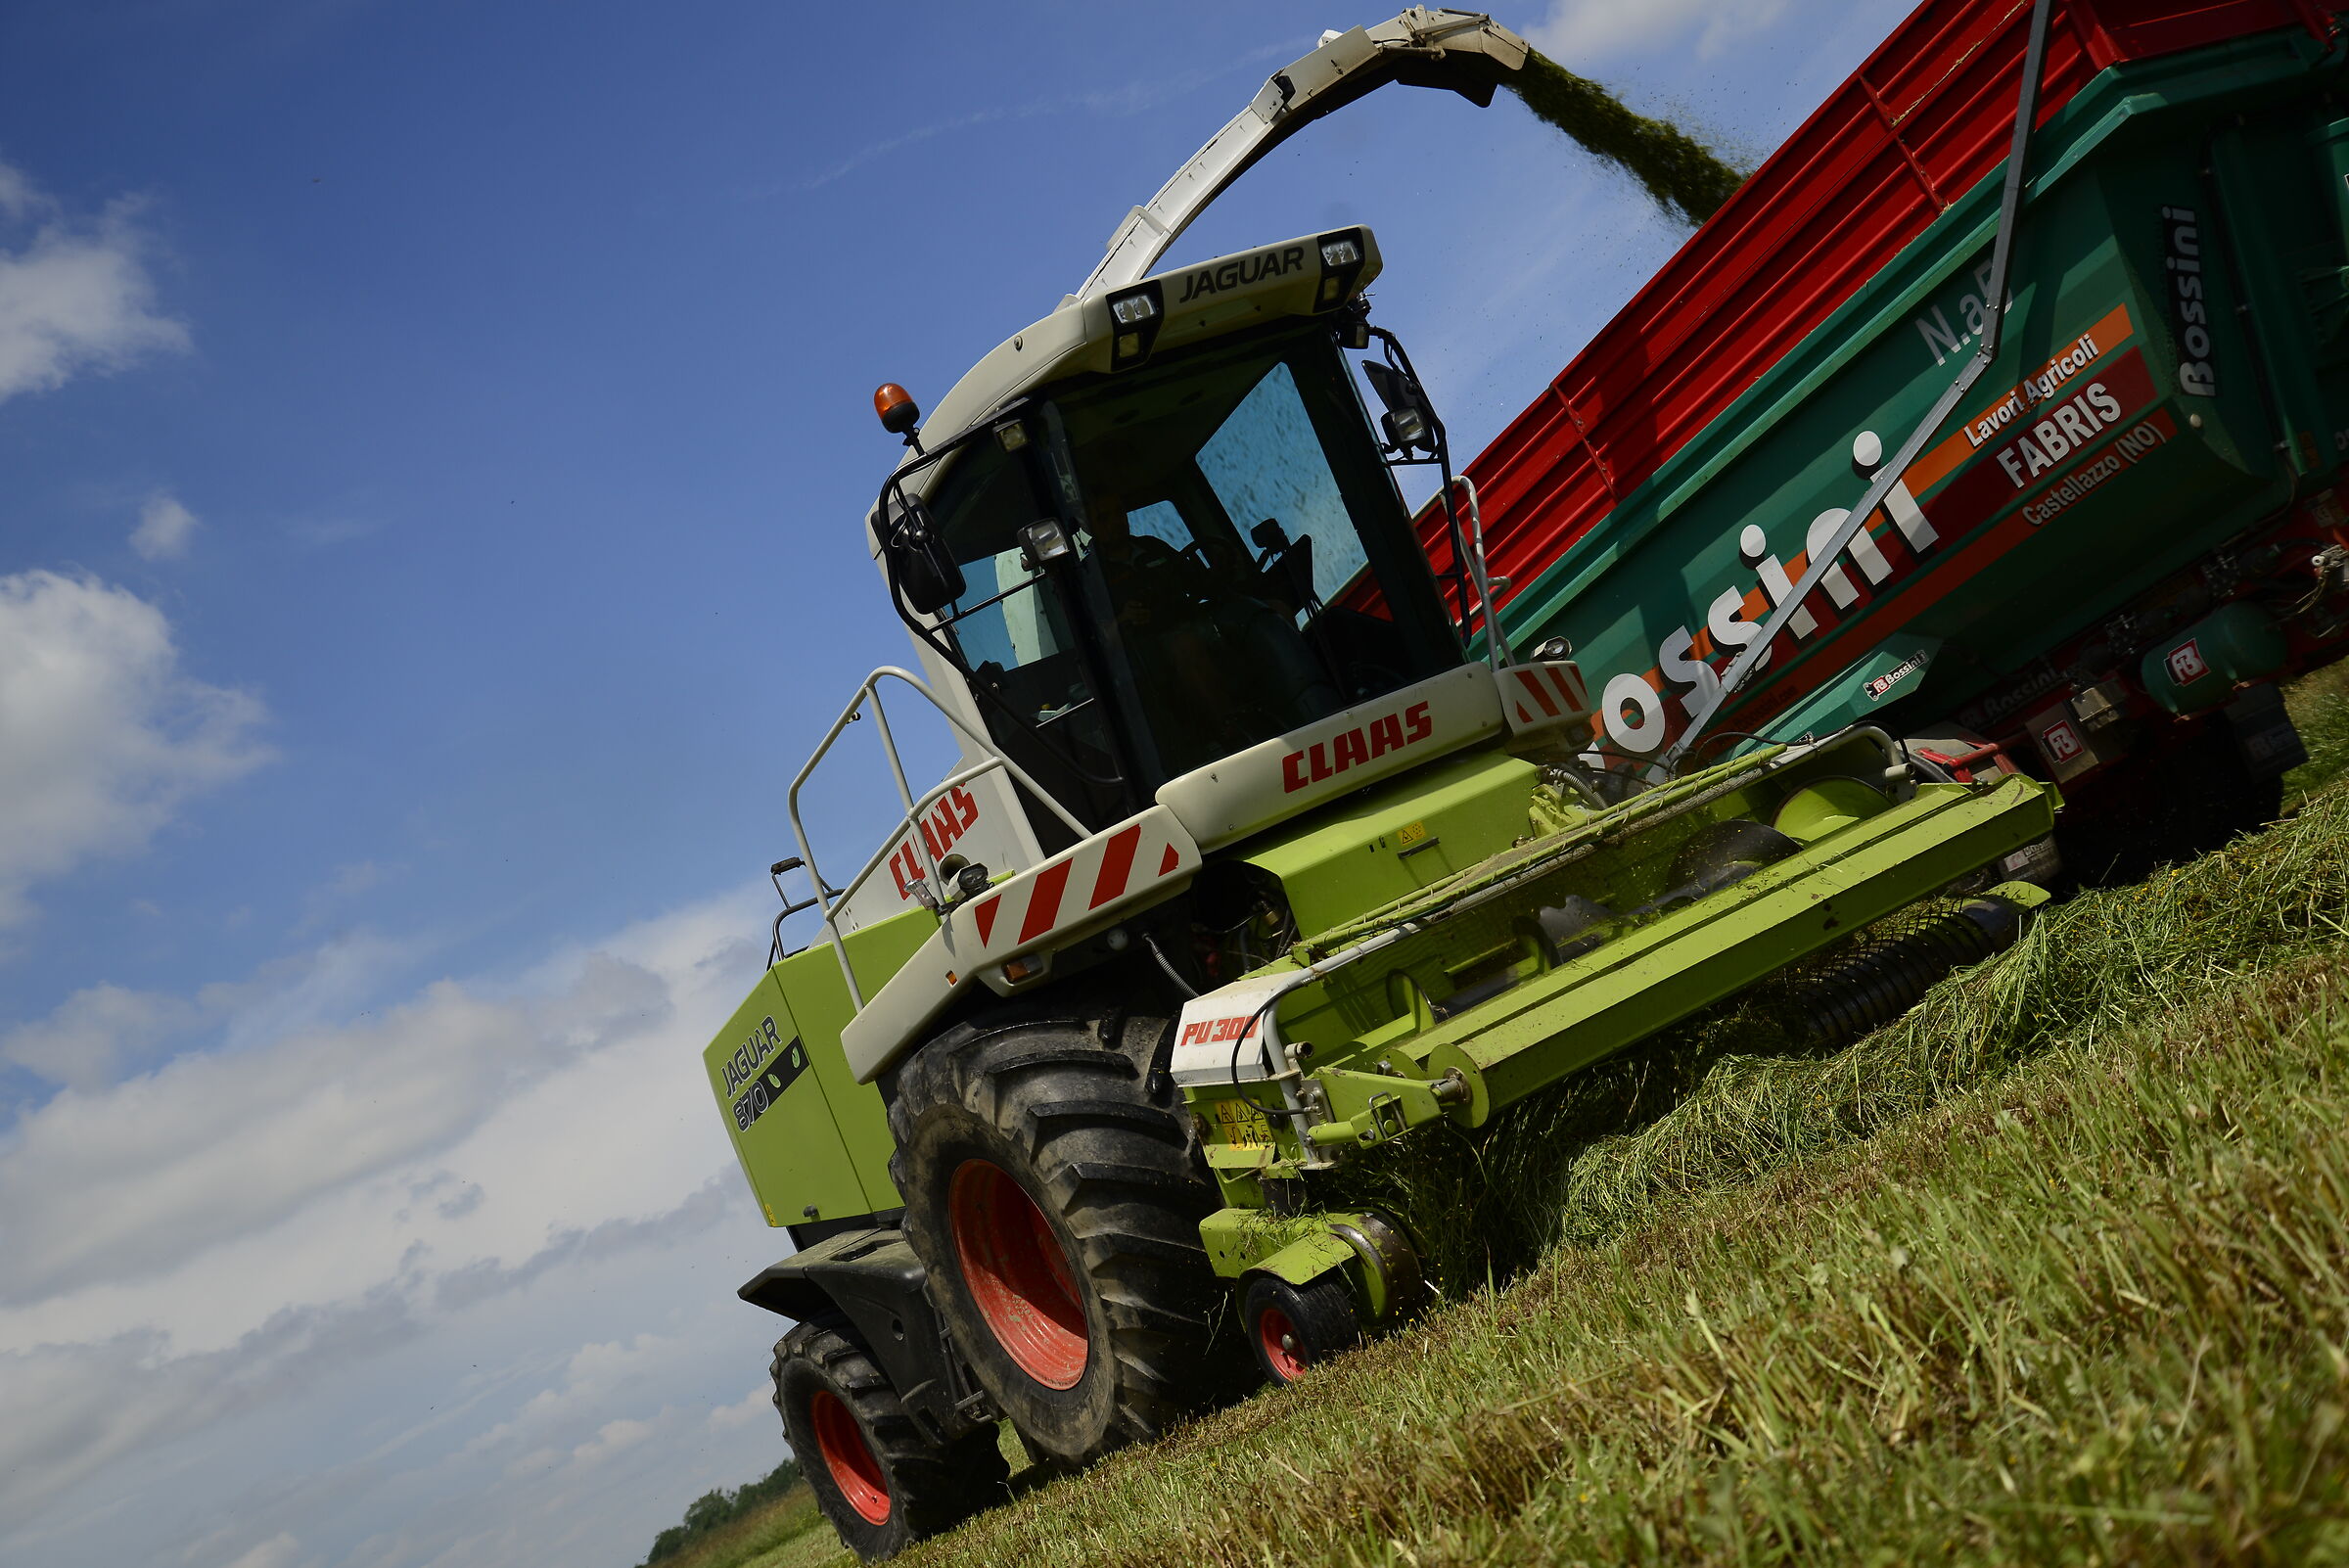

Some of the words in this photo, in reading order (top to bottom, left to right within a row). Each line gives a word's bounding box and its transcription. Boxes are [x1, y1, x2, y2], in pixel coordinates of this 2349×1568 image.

[1179, 247, 1305, 303] JAGUAR
[2162, 206, 2216, 396] Bossini
[1963, 390, 2025, 447] Lavori
[2023, 333, 2098, 403] Agricoli
[1996, 382, 2121, 488] FABRIS
[2022, 455, 2121, 525] Castellazzo
[2115, 421, 2166, 464] (NO)
[1578, 431, 1940, 774] ossini
[1884, 651, 1927, 684] Bossini
[1282, 700, 1432, 794] CLAAS
[721, 1015, 782, 1099] JAGUAR
[1180, 1020, 1215, 1046] PU
[1211, 1015, 1261, 1042] 300
[732, 1081, 769, 1132] 870
